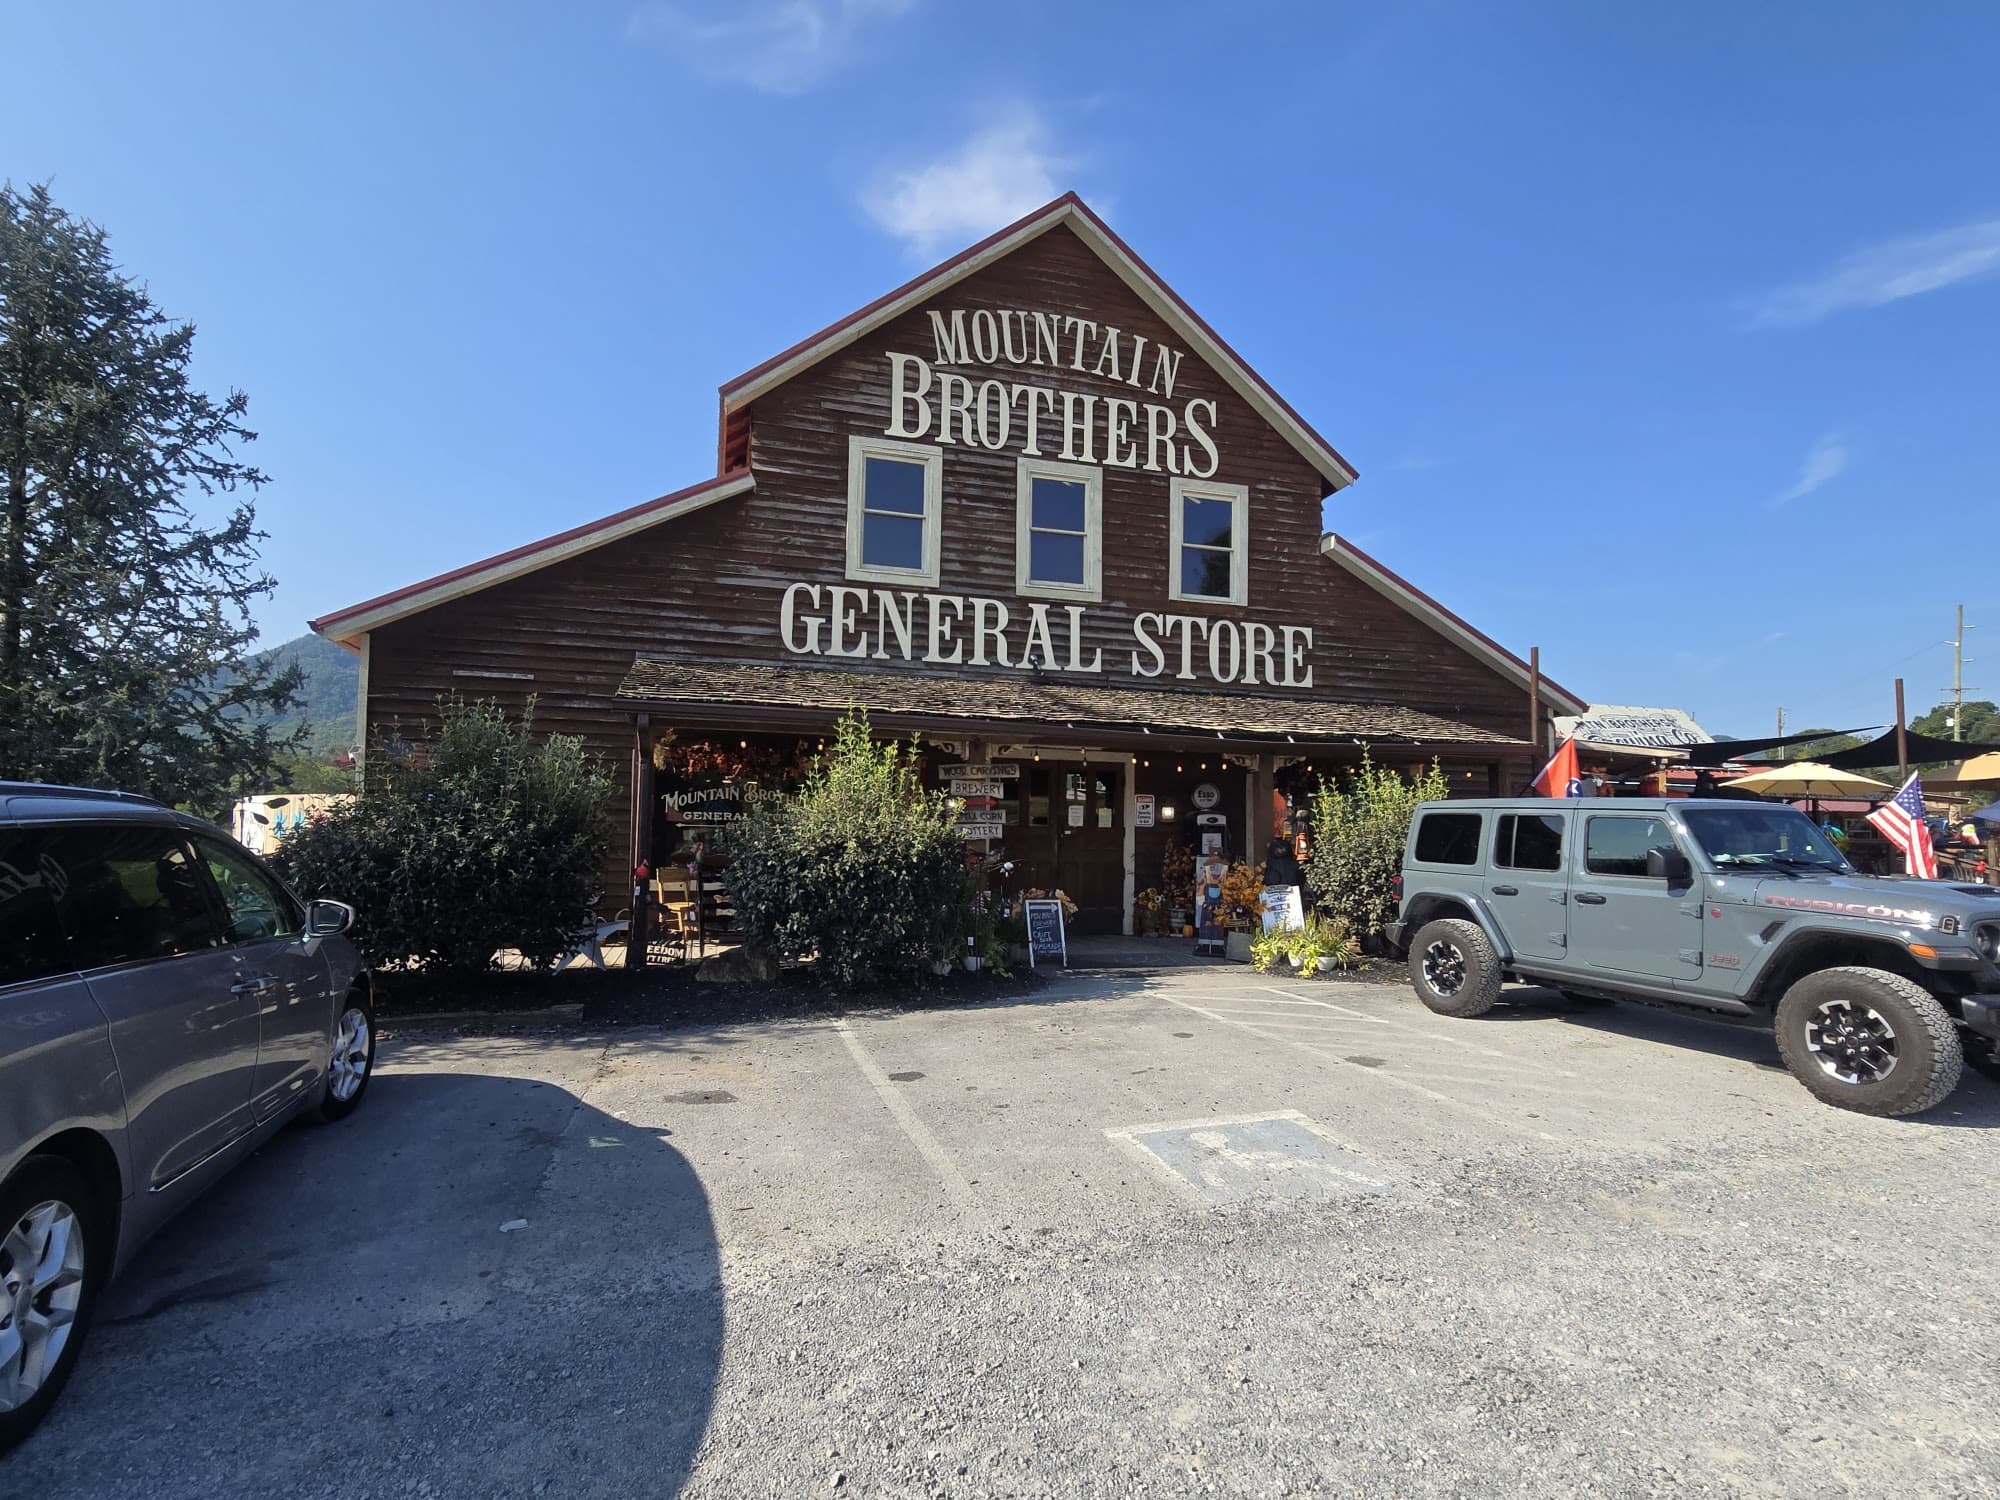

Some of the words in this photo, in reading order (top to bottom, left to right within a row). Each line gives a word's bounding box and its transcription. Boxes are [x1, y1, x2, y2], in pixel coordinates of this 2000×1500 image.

[926, 309, 1184, 399] MOUNTAIN
[884, 351, 1219, 478] BROTHERS
[780, 582, 1101, 673] GENERAL
[1131, 612, 1313, 688] STORE
[660, 785, 740, 813] MOUNTAIN
[955, 783, 1001, 794] BREWERY
[961, 826, 999, 836] OTTERY
[1764, 895, 1932, 923] RUBICON
[647, 945, 685, 959] EEDOM
[1710, 952, 1740, 967] Jeep
